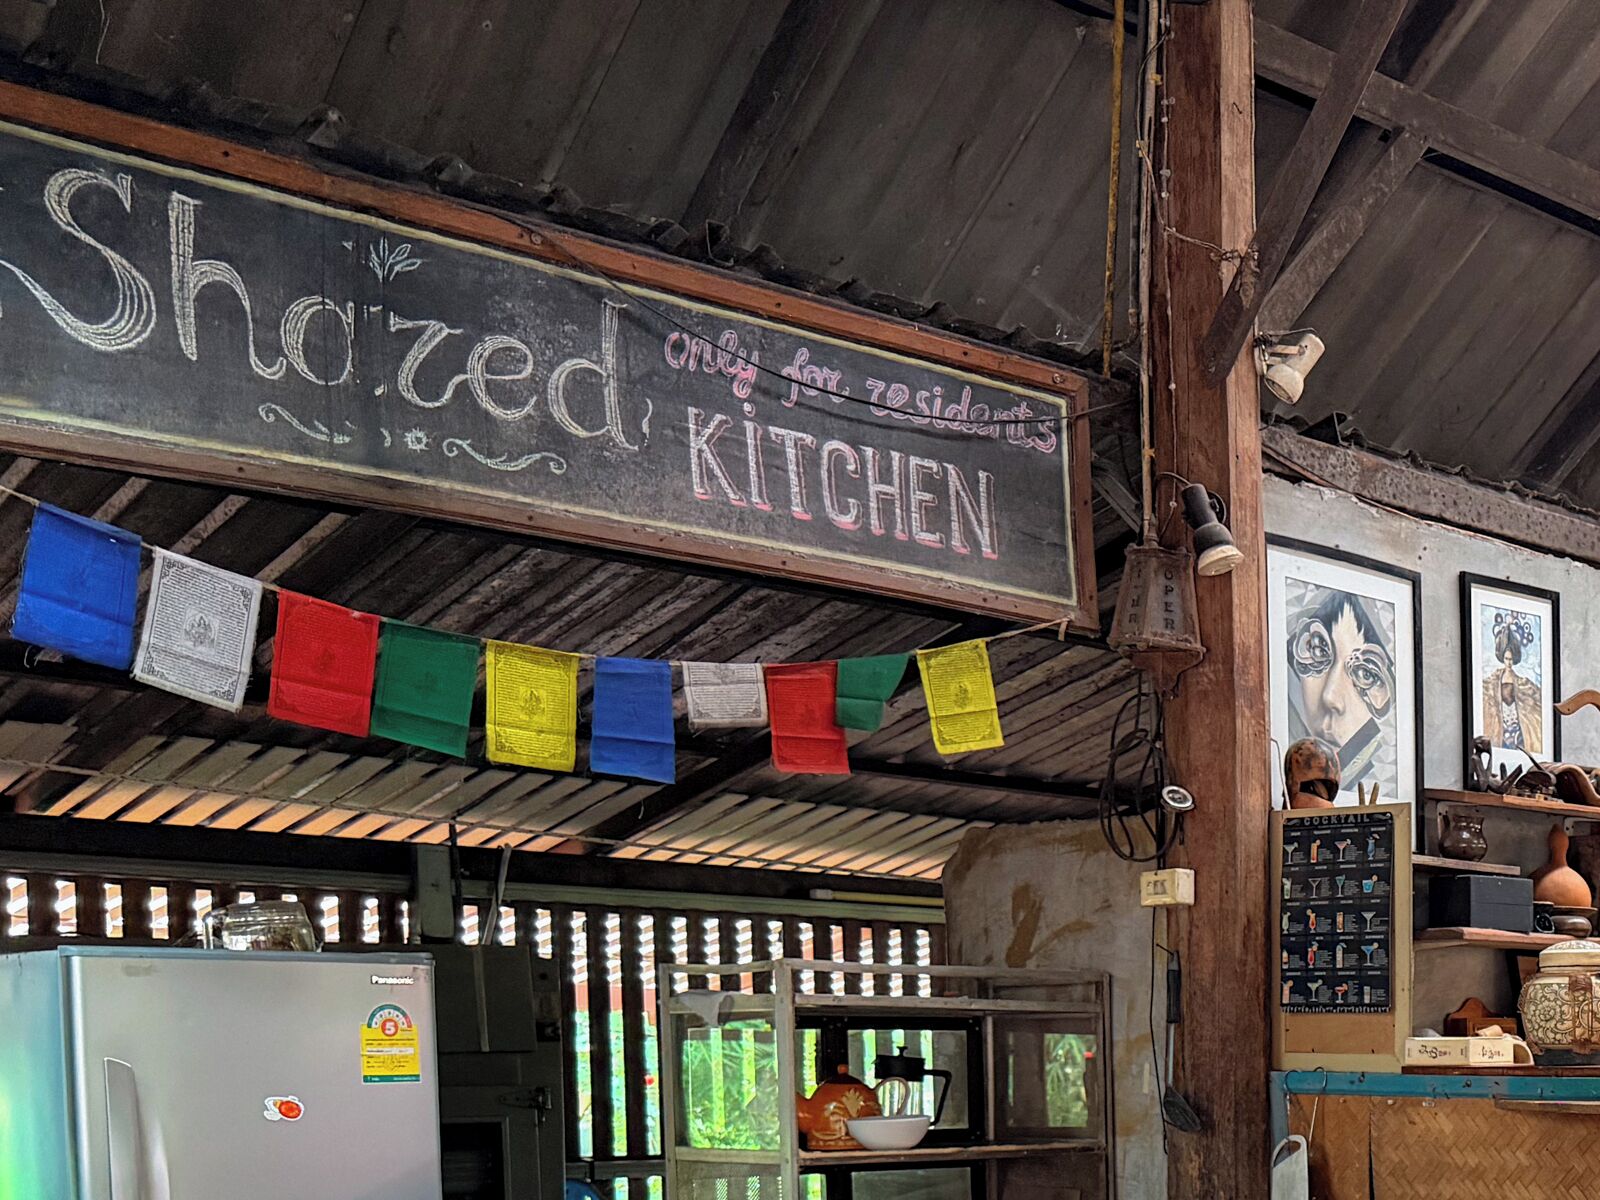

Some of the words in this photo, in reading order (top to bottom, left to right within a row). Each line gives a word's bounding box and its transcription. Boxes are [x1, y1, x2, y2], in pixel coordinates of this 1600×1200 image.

[0, 167, 640, 452] Shared
[664, 330, 760, 399] only
[781, 347, 850, 408] for
[865, 376, 1058, 454] residents
[1303, 814, 1370, 826] COCKTAIL
[371, 975, 415, 985] Panasonic
[385, 1021, 396, 1035] 5
